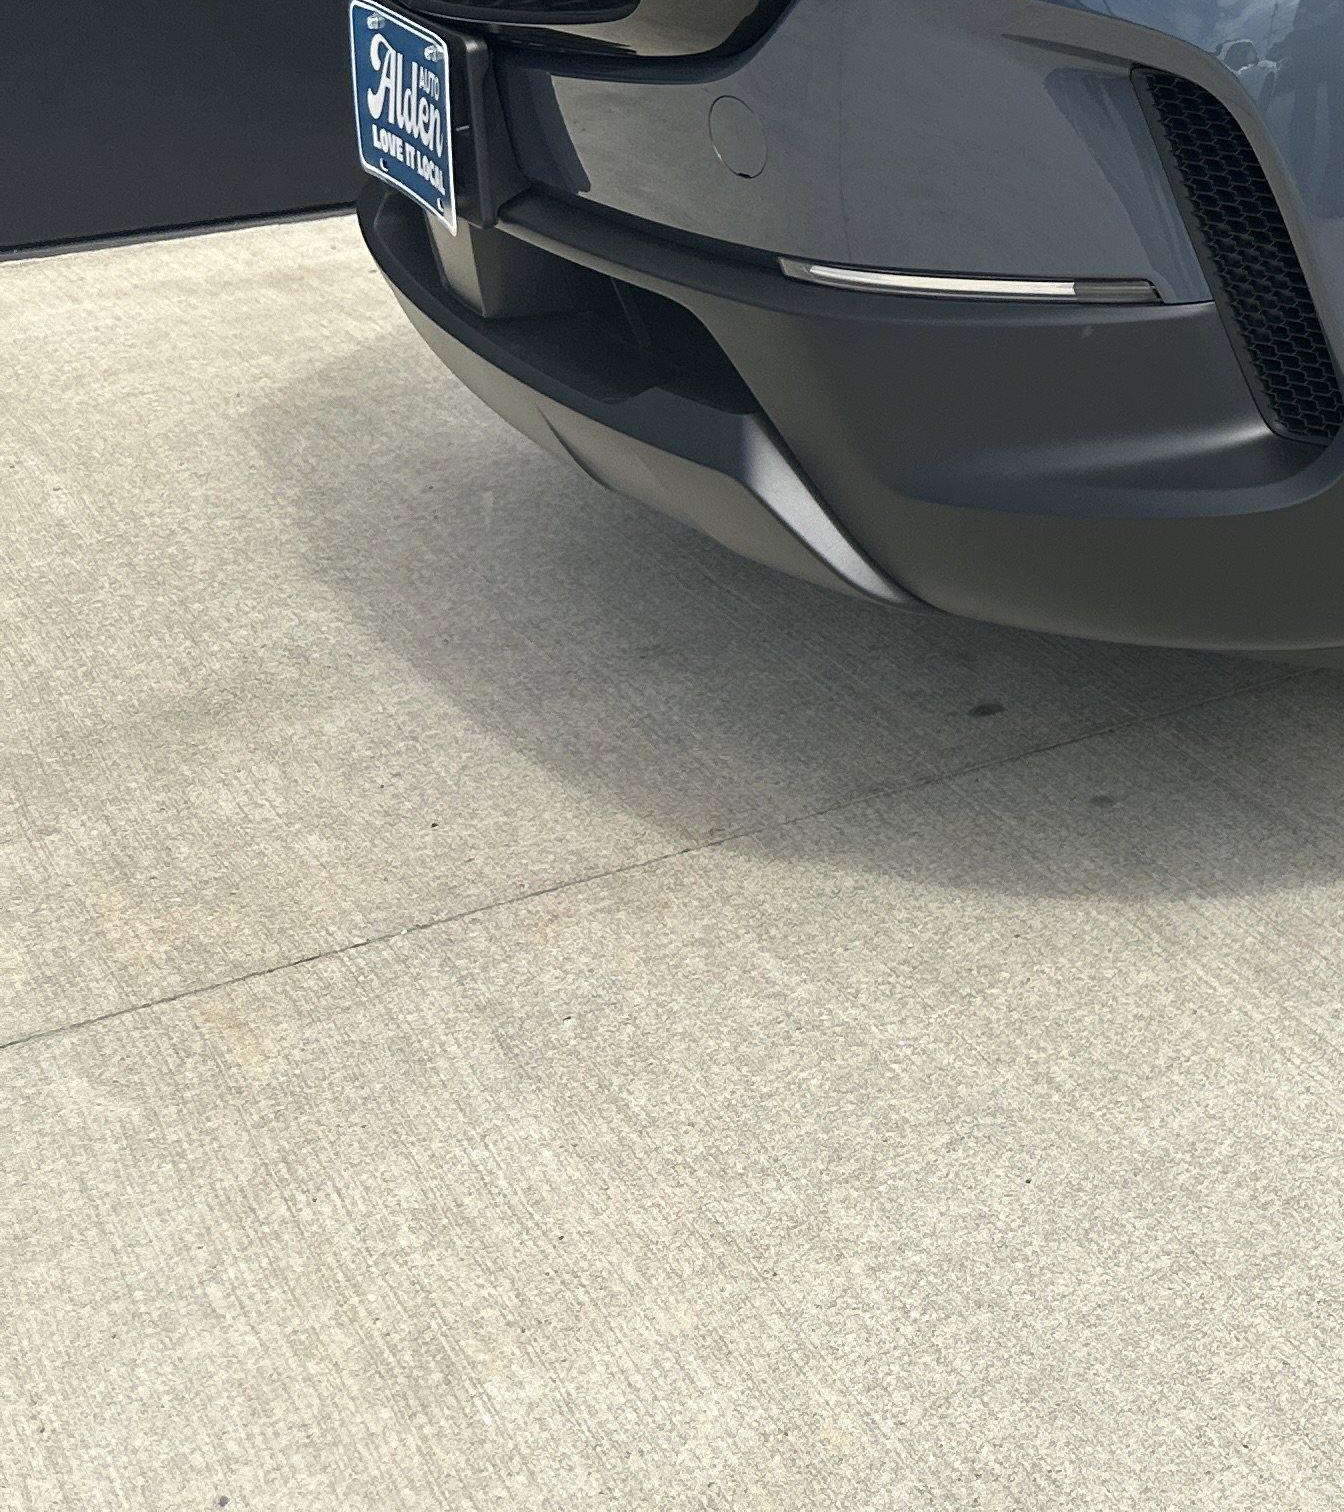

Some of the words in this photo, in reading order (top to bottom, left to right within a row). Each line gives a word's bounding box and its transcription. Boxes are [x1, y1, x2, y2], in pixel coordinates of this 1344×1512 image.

[367, 33, 444, 158] Alden
[419, 65, 440, 102] AUTO
[372, 124, 404, 162] LOVE
[406, 144, 416, 170] IT
[417, 153, 446, 196] LOCAL
